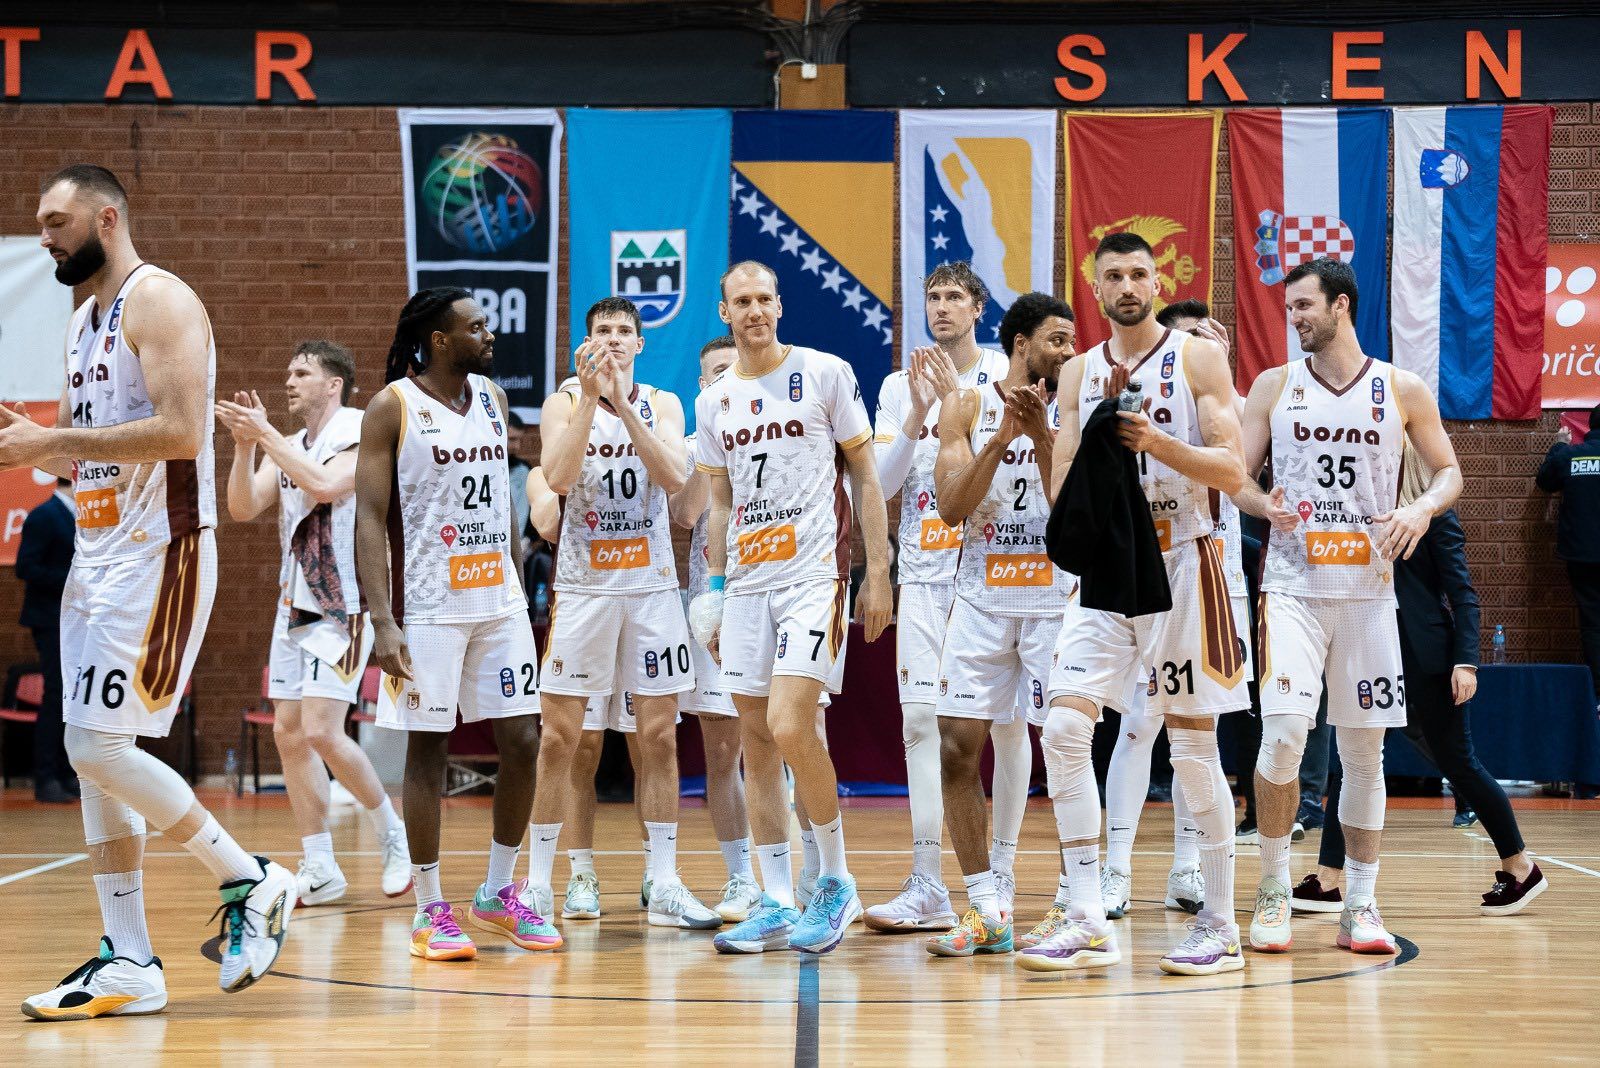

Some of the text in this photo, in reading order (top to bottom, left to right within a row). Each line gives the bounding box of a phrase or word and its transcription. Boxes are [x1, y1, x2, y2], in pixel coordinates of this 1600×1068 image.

[1054, 29, 1522, 102] SKEN
[472, 287, 527, 334] BA
[722, 420, 804, 451] bosna
[1294, 422, 1380, 446] bosna
[432, 444, 504, 465] bosna
[1002, 448, 1037, 465] osn
[751, 453, 767, 488] 7
[1317, 454, 1356, 489] 35
[461, 474, 492, 510] 24
[602, 468, 637, 499] 10
[1013, 477, 1027, 511] 2
[599, 511, 627, 520] VISIT
[744, 500, 768, 512] VISIT
[744, 507, 802, 525] SARAJEVO
[1313, 501, 1344, 511] VISIT
[458, 522, 485, 533] VISIT
[925, 525, 948, 543] bh
[996, 523, 1025, 533] VISIT
[996, 536, 1048, 545] SARAJEV
[1311, 539, 1339, 557] bh
[596, 547, 622, 562] bh
[457, 562, 480, 581] bh
[991, 562, 1017, 579] bh
[809, 629, 825, 661] 7
[660, 643, 690, 677] 10
[82, 665, 127, 709] 16
[521, 662, 540, 695] 2
[1162, 659, 1194, 695] 31
